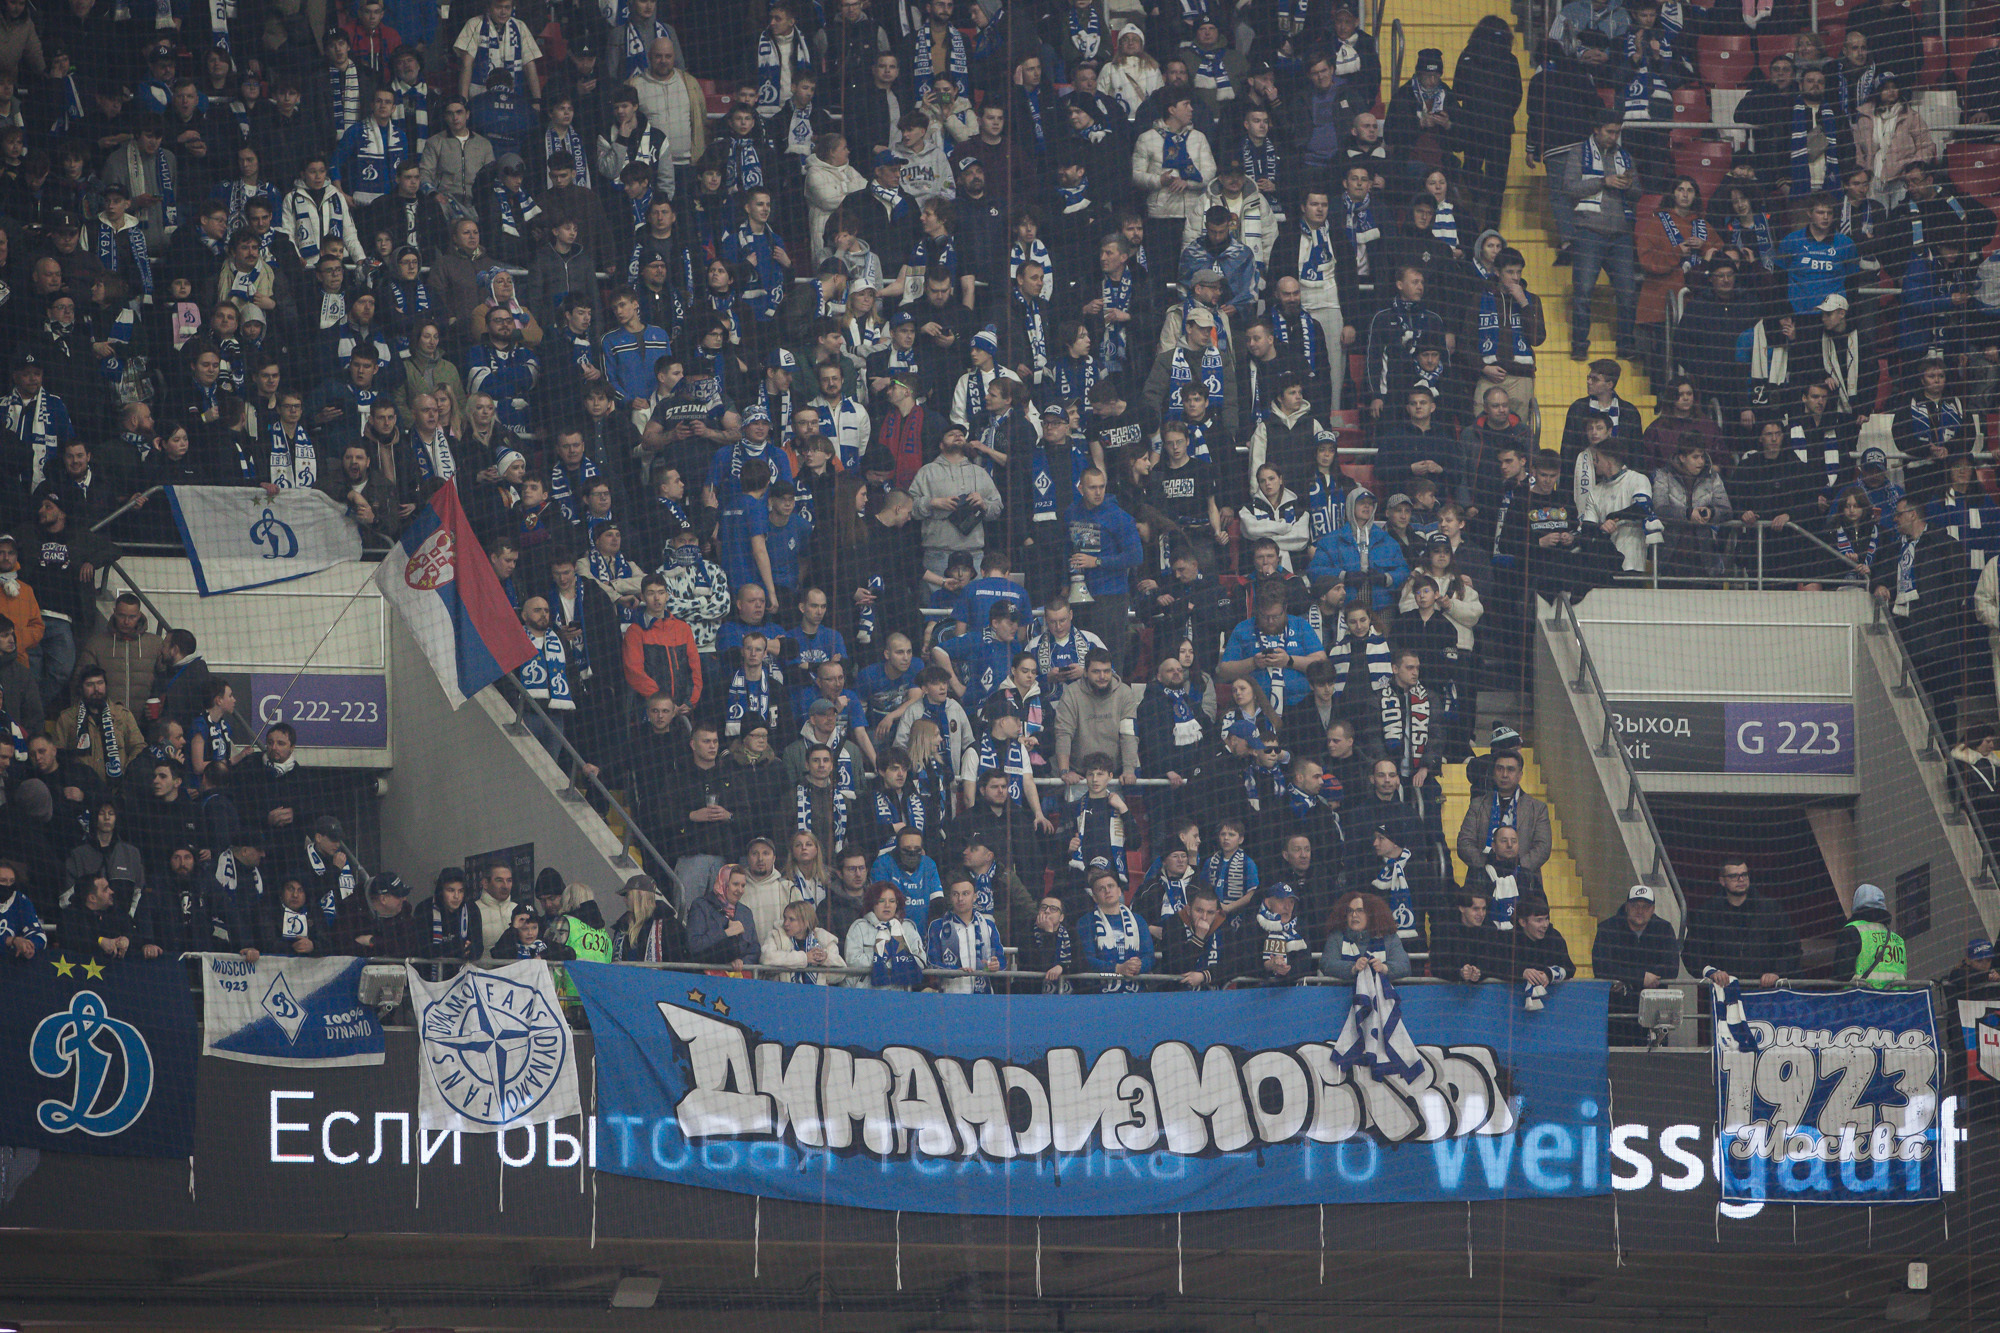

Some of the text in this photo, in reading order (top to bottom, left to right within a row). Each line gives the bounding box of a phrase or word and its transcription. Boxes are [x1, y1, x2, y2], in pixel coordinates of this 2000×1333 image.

[900, 165, 936, 183] PUMA
[1811, 259, 1833, 271] ВТБ
[1034, 500, 1053, 509] 1923
[43, 551, 65, 561] GANG
[259, 694, 379, 725] G 222-223
[1624, 739, 1651, 759] xit
[1736, 721, 1841, 755] G 223
[212, 957, 256, 977] MOSCOW
[323, 1007, 364, 1026] 100%
[427, 982, 547, 1036] DYNAMO FANS
[325, 1018, 372, 1040] DYNAMO
[1743, 1020, 1933, 1050] Динамо
[431, 1035, 558, 1117] DYNAMO FANS
[1720, 1044, 1938, 1138] 1923
[1729, 1119, 1933, 1163] Москва
